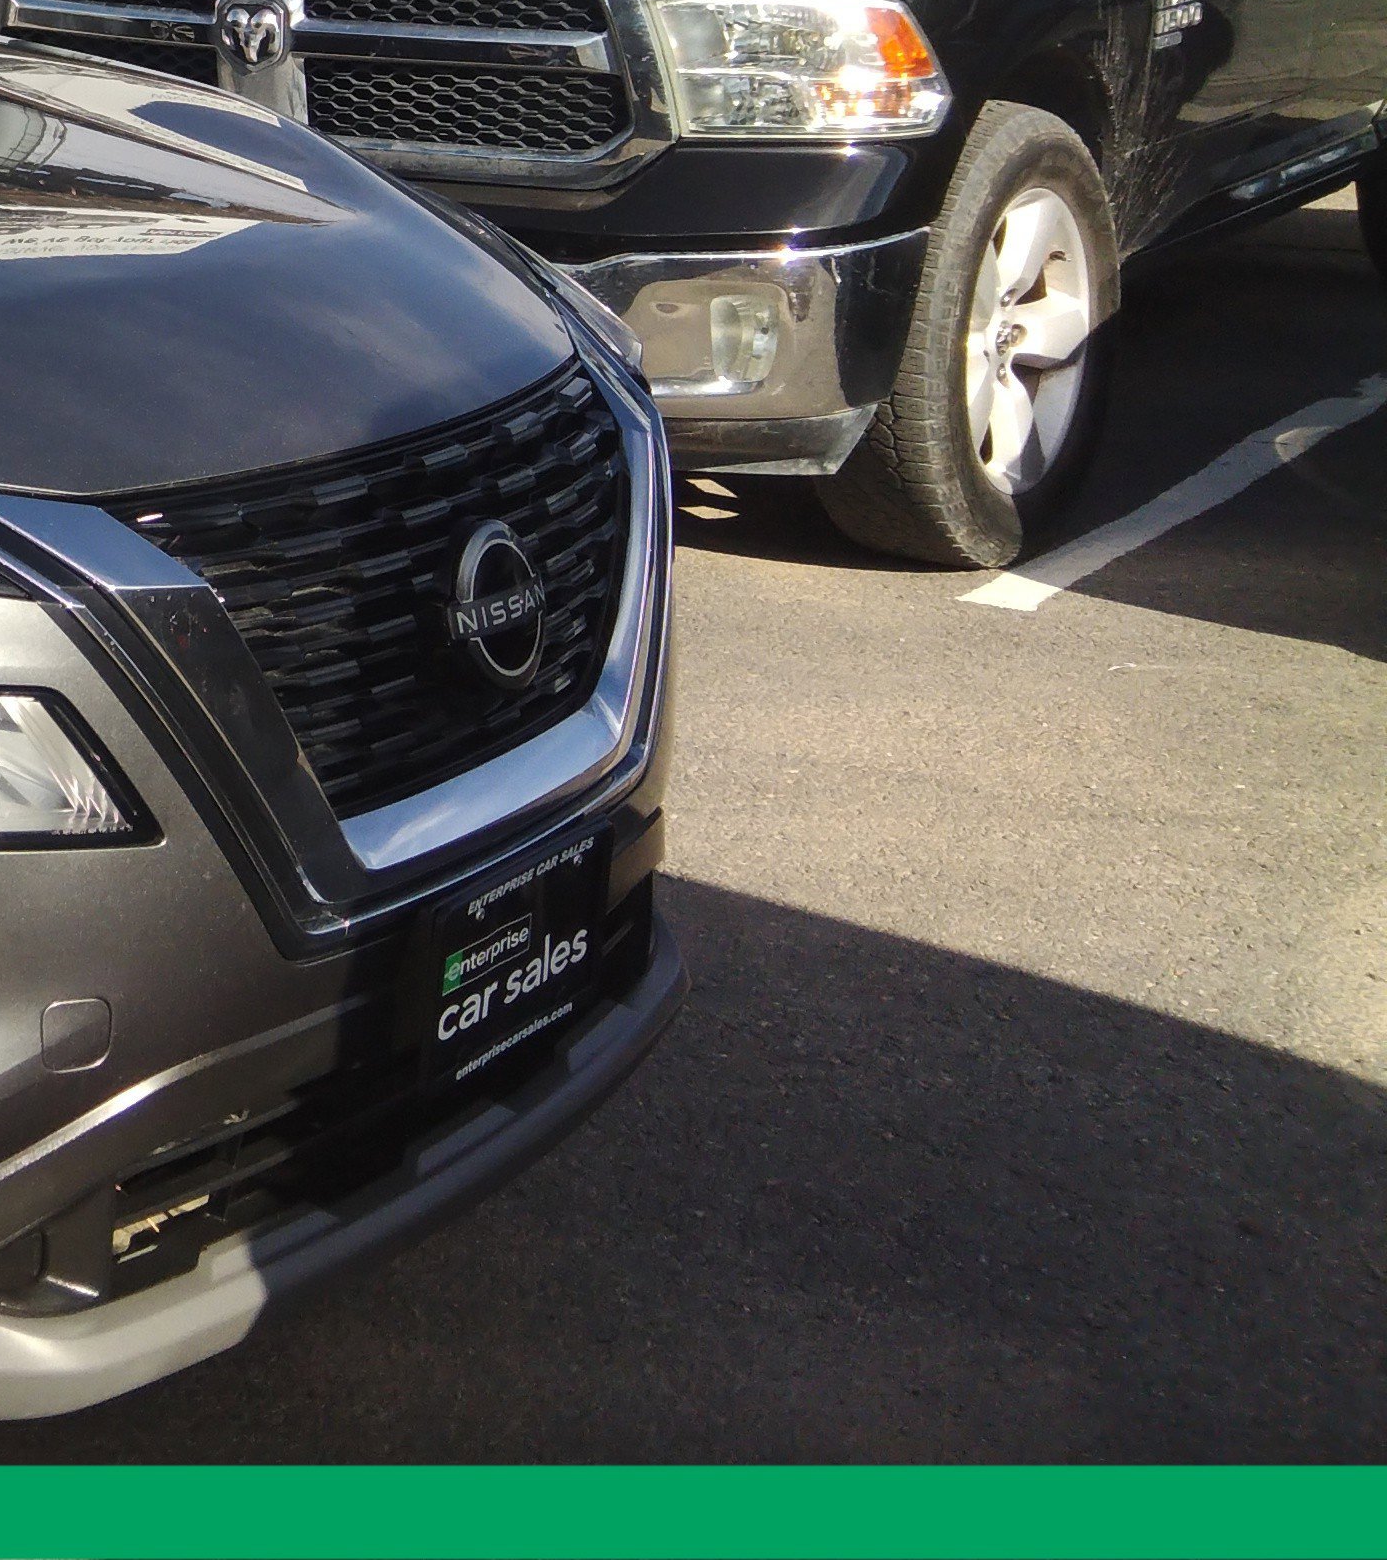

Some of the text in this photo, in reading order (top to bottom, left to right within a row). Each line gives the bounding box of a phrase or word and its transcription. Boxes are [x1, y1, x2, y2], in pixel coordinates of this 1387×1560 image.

[456, 584, 546, 634] NISSAN
[467, 837, 595, 916] ENTERPRISE CAR SALES
[438, 929, 588, 1041] car sales
[444, 927, 529, 981] enterprise
[455, 1001, 574, 1081] enterprisecarsales.com
